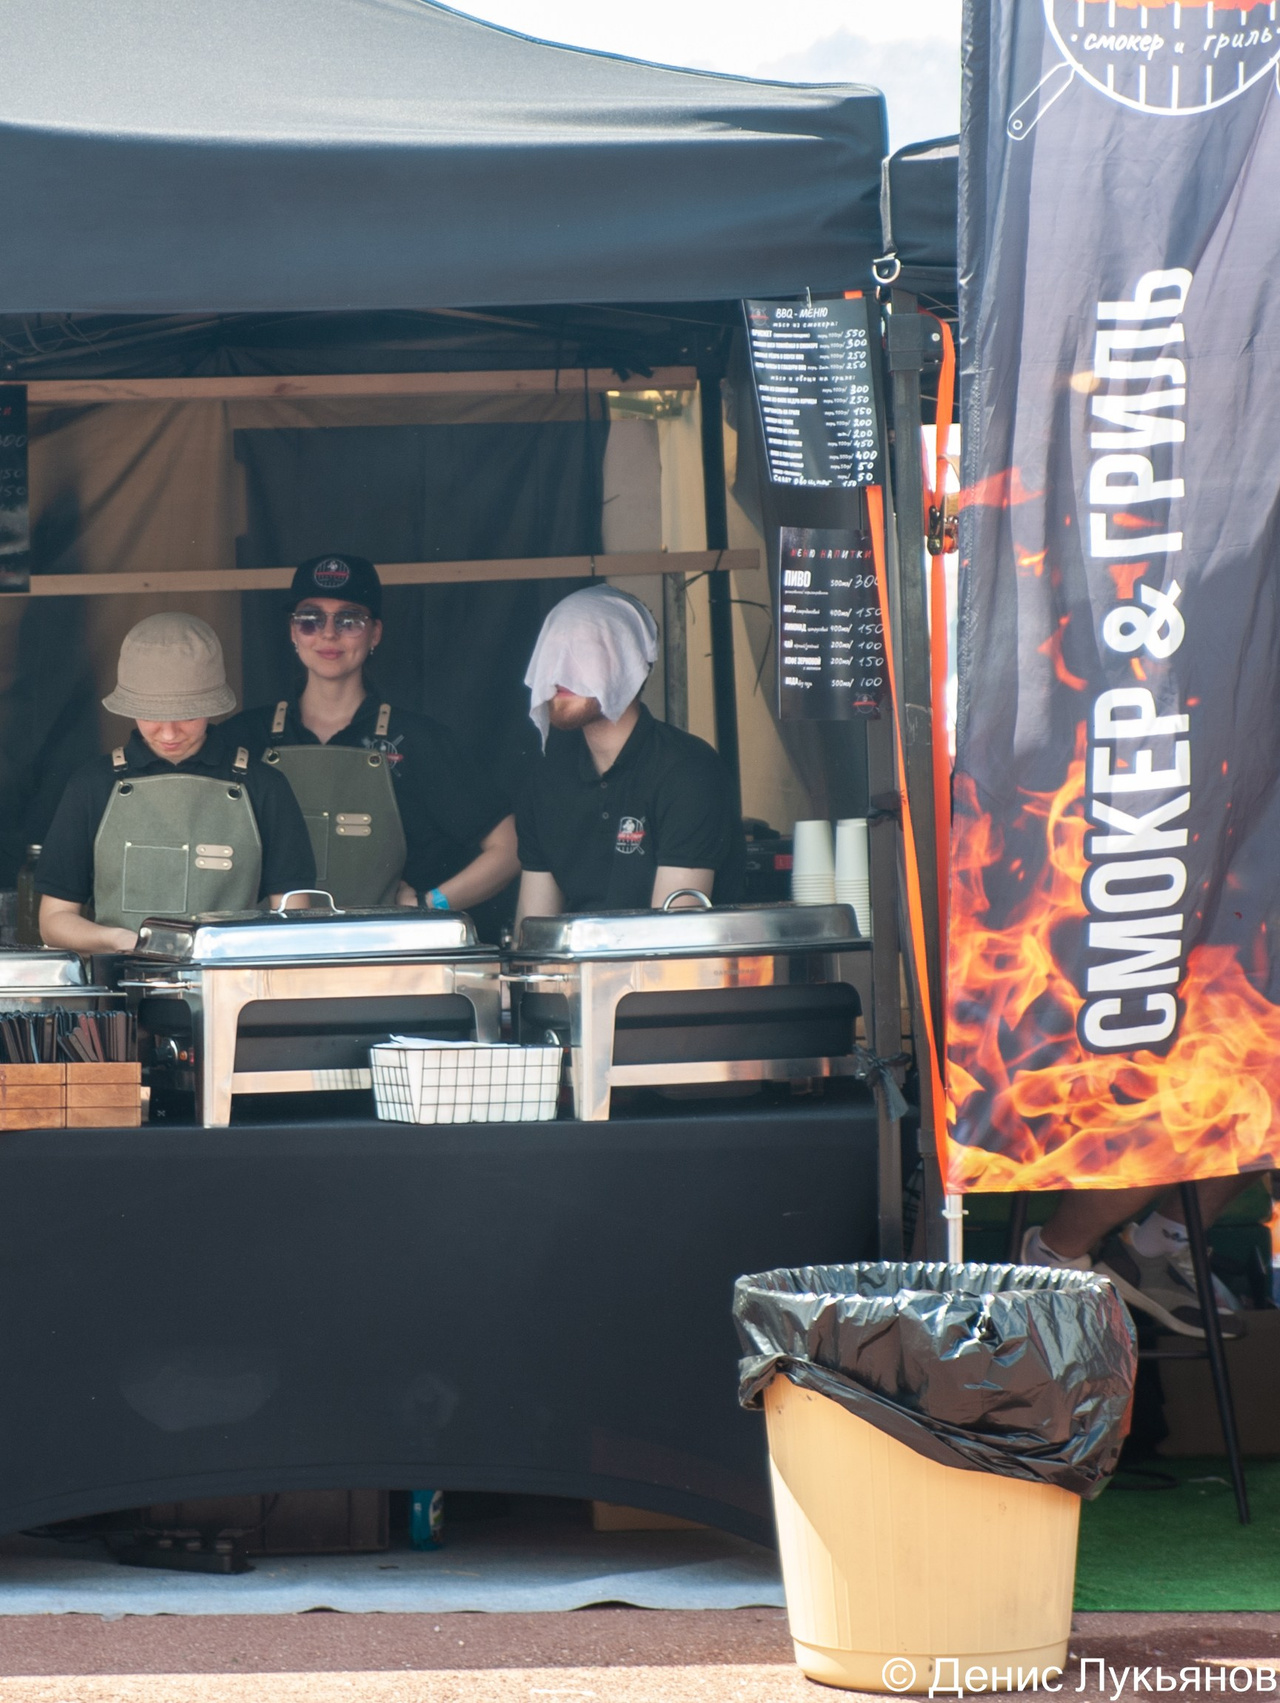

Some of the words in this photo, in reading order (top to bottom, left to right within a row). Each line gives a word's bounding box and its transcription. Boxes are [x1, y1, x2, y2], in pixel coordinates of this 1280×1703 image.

[1084, 33, 1164, 61] смокер
[1174, 42, 1185, 54] и
[1203, 28, 1272, 58] гриль
[776, 308, 793, 319] BBQ
[799, 307, 828, 318] МЕНЮ
[845, 329, 866, 338] 550
[846, 339, 867, 349] 300
[847, 351, 866, 360] 250
[846, 361, 867, 369] 250
[850, 385, 869, 395] 300
[850, 396, 869, 405] 250
[854, 407, 872, 416] 150
[1089, 267, 1193, 558] ГРИЛЬ
[854, 419, 872, 427] 200
[853, 429, 872, 439] 200
[854, 439, 873, 448] 450
[855, 450, 877, 460] 400
[857, 462, 873, 471] 50
[791, 549, 815, 558] МЕНЮ
[821, 549, 872, 559] НАПИТКИ
[784, 570, 811, 587] ПИВО
[1103, 580, 1185, 659] &
[858, 624, 883, 634] 150
[858, 642, 882, 650] 100
[859, 656, 883, 667] 150
[861, 677, 883, 687] 100
[1084, 687, 1191, 1048] СМОКЕР
